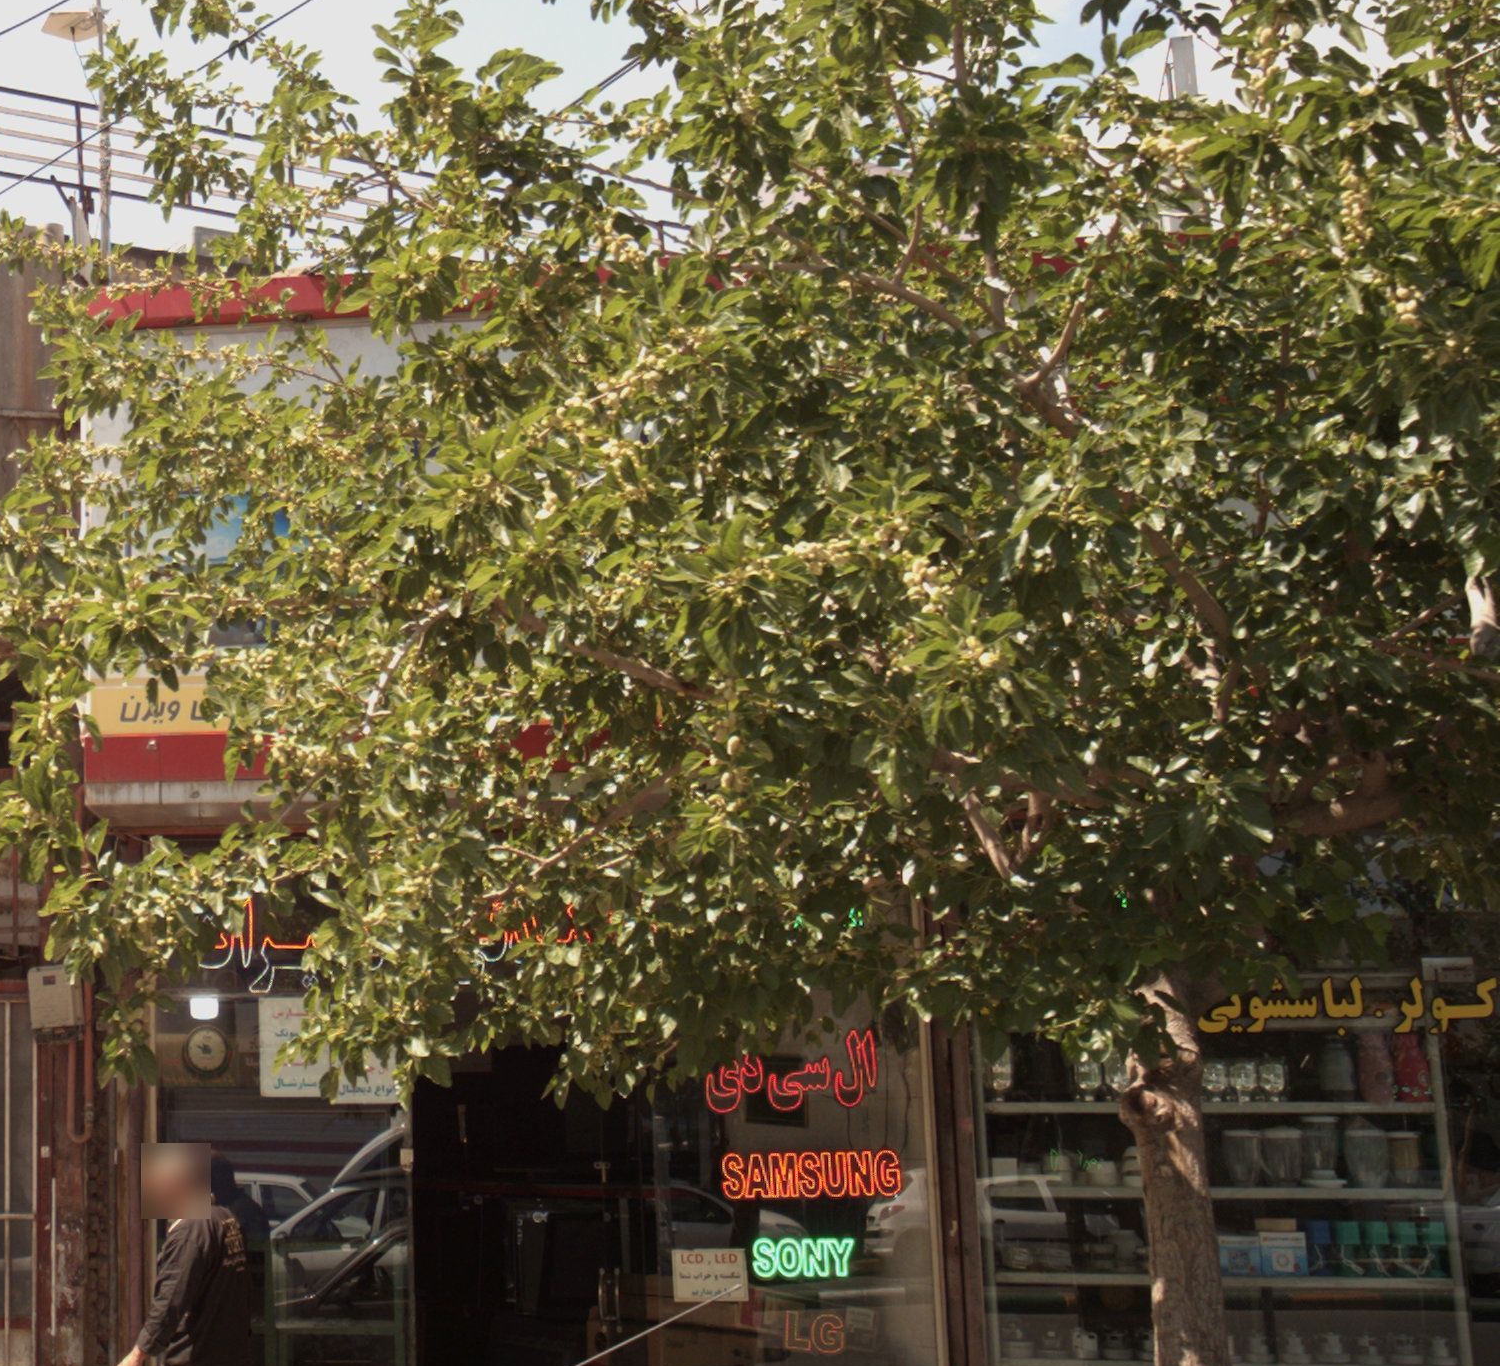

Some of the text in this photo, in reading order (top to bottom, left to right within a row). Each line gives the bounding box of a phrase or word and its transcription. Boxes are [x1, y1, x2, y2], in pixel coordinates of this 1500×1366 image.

[1197, 975, 1499, 1036] کولر لباسشویی
[767, 1056, 832, 1112] سی
[833, 1029, 878, 1108] ال
[721, 1149, 902, 1201] SAMSUNG
[681, 1253, 704, 1264] LCD
[715, 1253, 738, 1264] LED
[752, 1237, 854, 1279] SONY
[784, 1309, 845, 1354] LG
